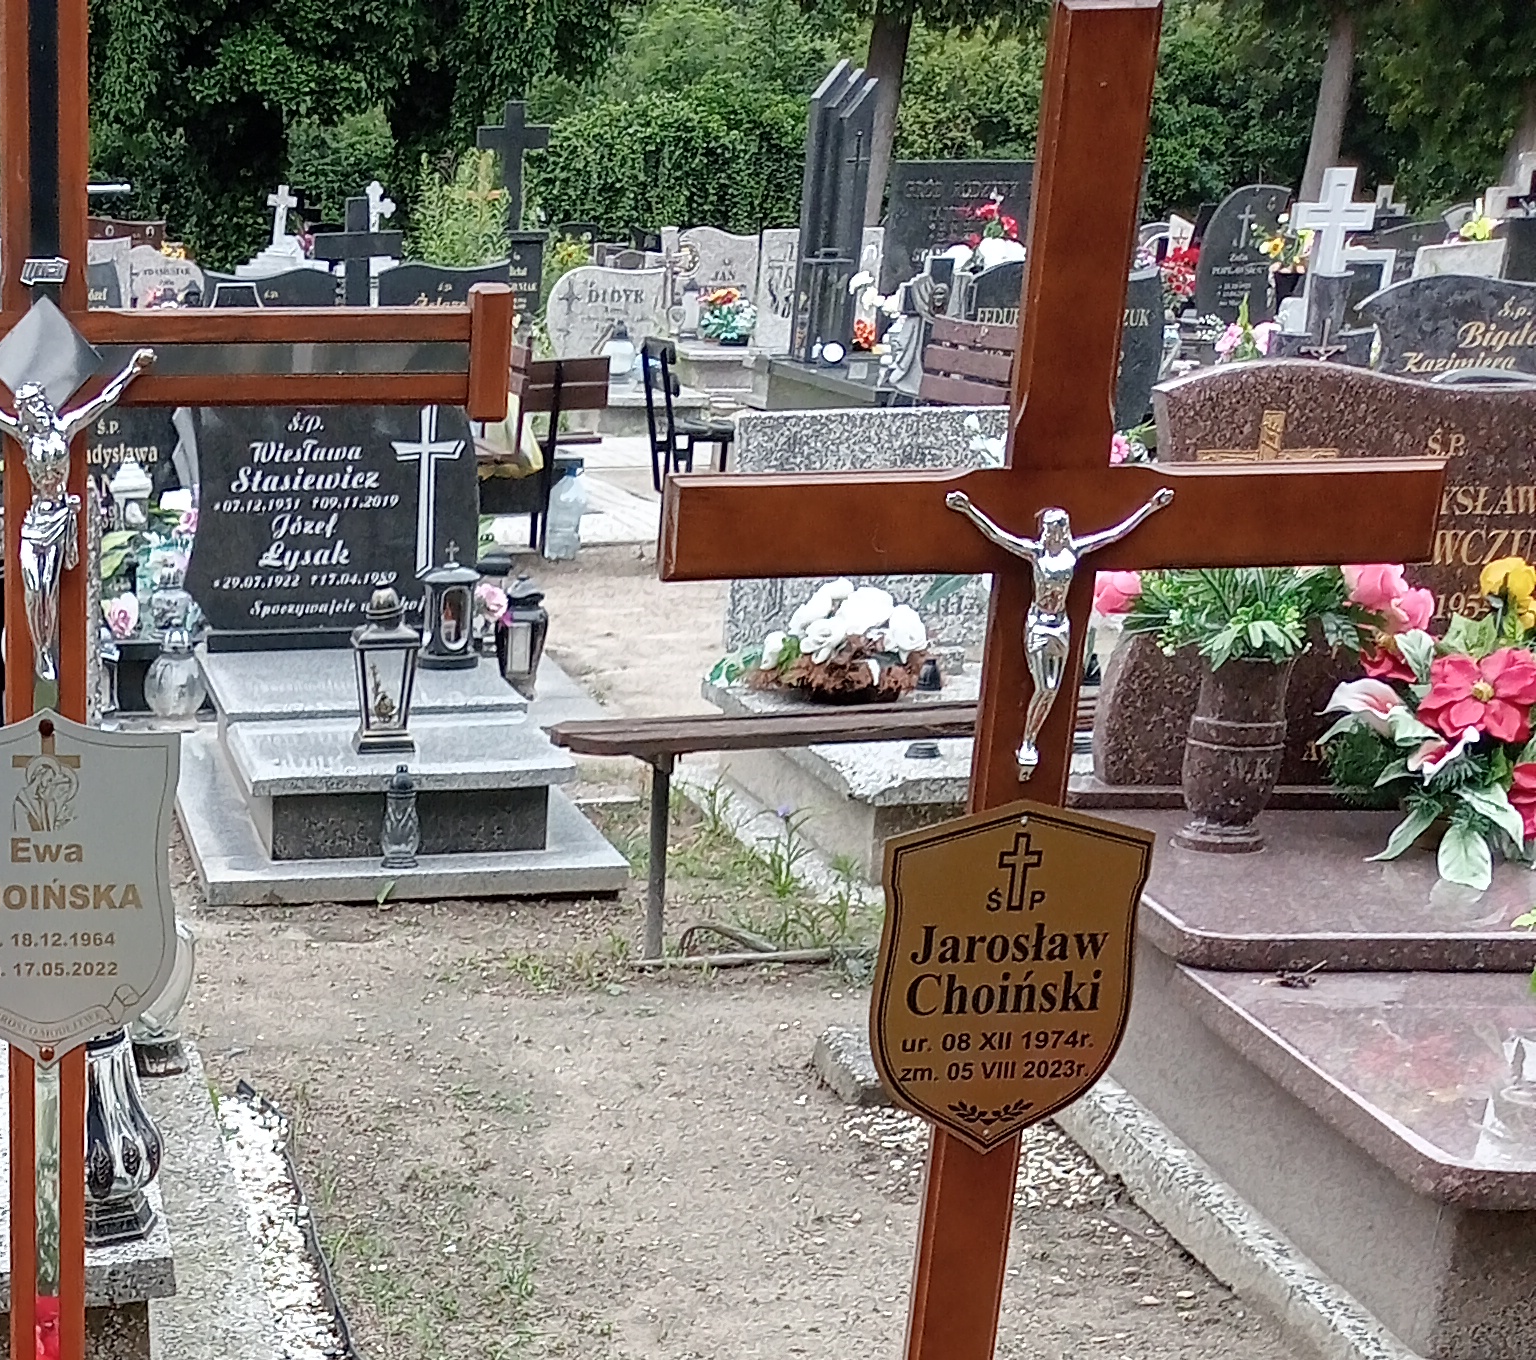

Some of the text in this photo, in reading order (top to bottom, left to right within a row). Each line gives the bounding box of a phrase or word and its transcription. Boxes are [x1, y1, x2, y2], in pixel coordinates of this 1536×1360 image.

[249, 438, 363, 464] Wiesława
[230, 465, 381, 493] Stasiewicz
[271, 513, 339, 539] Józef
[10, 837, 84, 864] Ewa
[985, 888, 1046, 912] Ś P
[11, 932, 116, 948] 18.12.1964
[910, 922, 1111, 966] Jarosław
[13, 961, 119, 977] 17.05.2022
[905, 968, 1103, 1017] Choiński
[901, 1030, 1095, 1053] ur. 08 XII 1974r.
[899, 1059, 1090, 1082] zm. 05 VIII 2023r.
